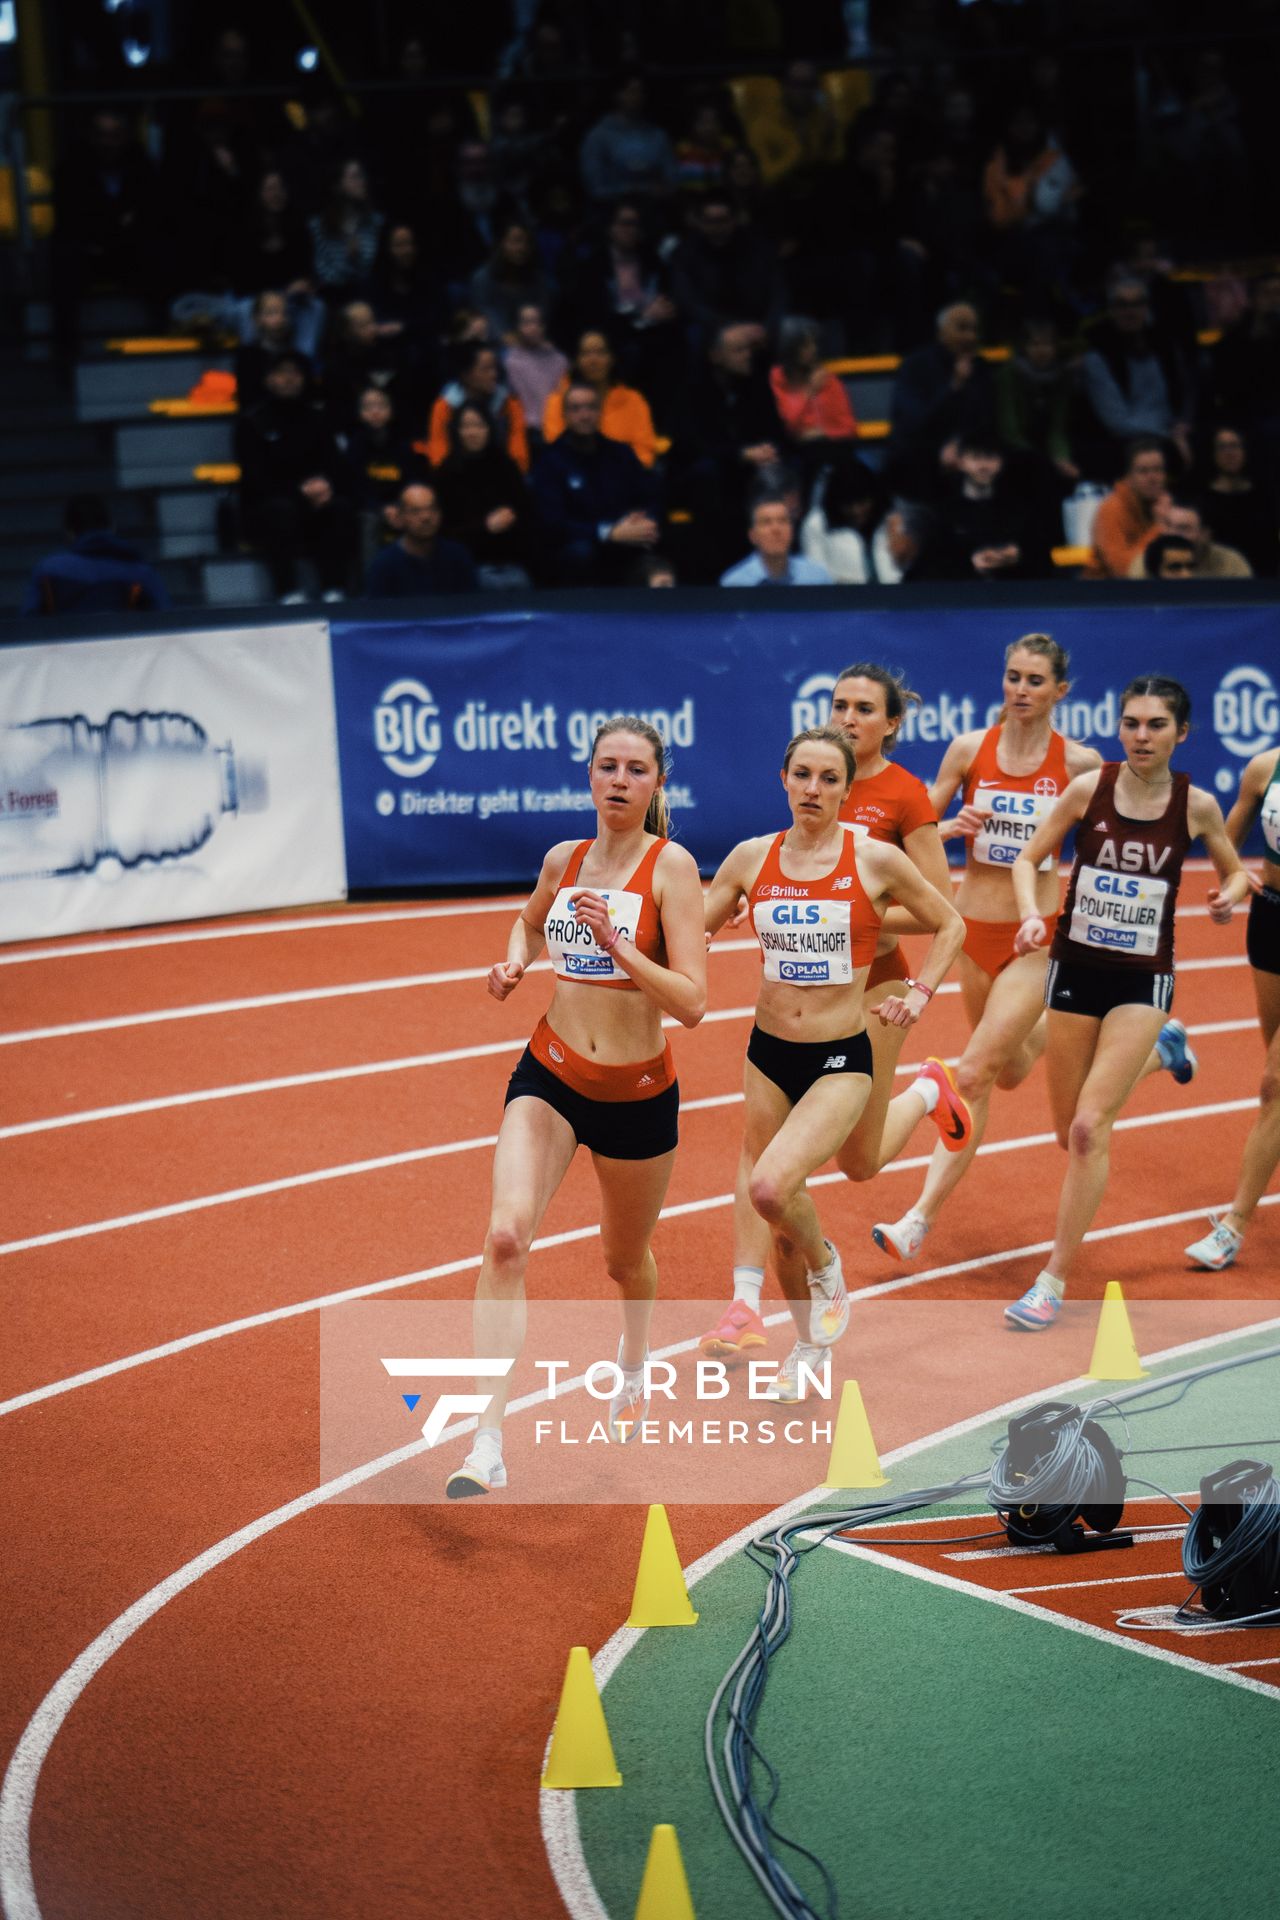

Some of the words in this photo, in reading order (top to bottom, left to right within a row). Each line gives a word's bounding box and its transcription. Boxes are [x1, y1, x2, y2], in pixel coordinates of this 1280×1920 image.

[454, 700, 557, 751] direkt
[1213, 688, 1279, 737] BIG
[374, 703, 441, 754] BIG
[402, 788, 475, 815] Direkter
[478, 787, 519, 819] geht
[984, 819, 1037, 841] WRED
[1094, 838, 1172, 875] ASV
[770, 885, 809, 897] Brillux
[1080, 895, 1156, 926] COUTELLIER
[761, 932, 799, 953] SCHULZE
[800, 932, 846, 953] KALTHOFF
[1106, 931, 1135, 944] PLAN
[580, 958, 611, 967] PLAN
[797, 965, 827, 975] PLAN
